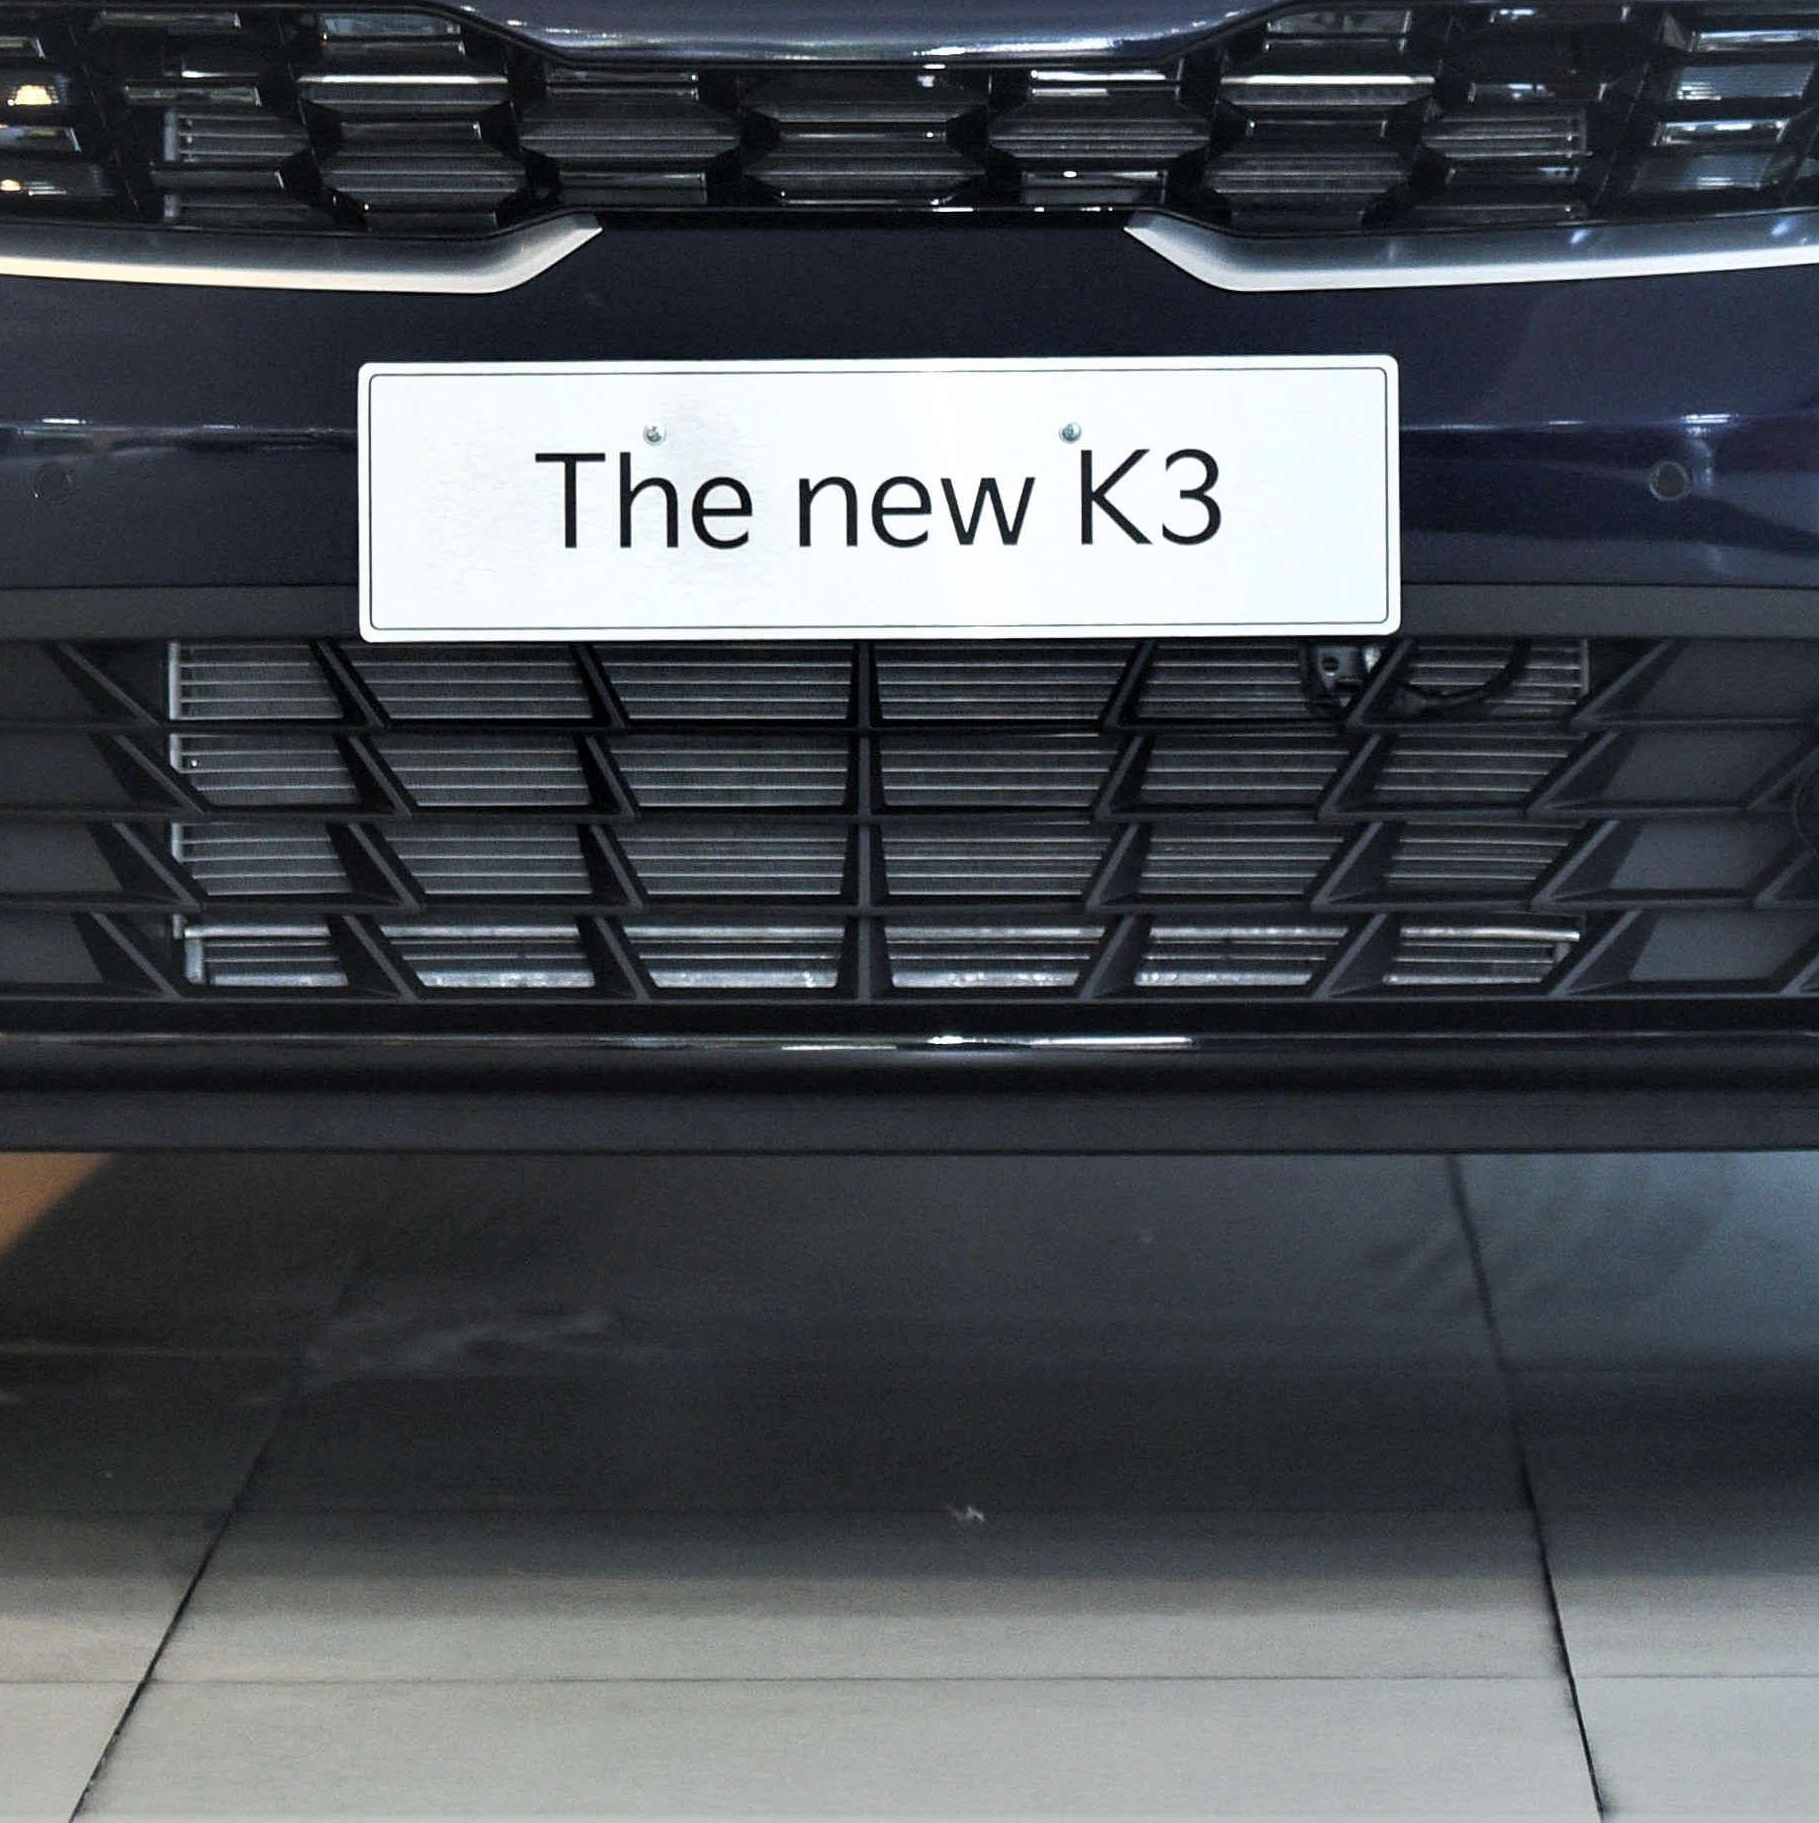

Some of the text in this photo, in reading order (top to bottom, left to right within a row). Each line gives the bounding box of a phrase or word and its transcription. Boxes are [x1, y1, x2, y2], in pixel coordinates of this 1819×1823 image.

[535, 448, 1221, 550] The new K3
